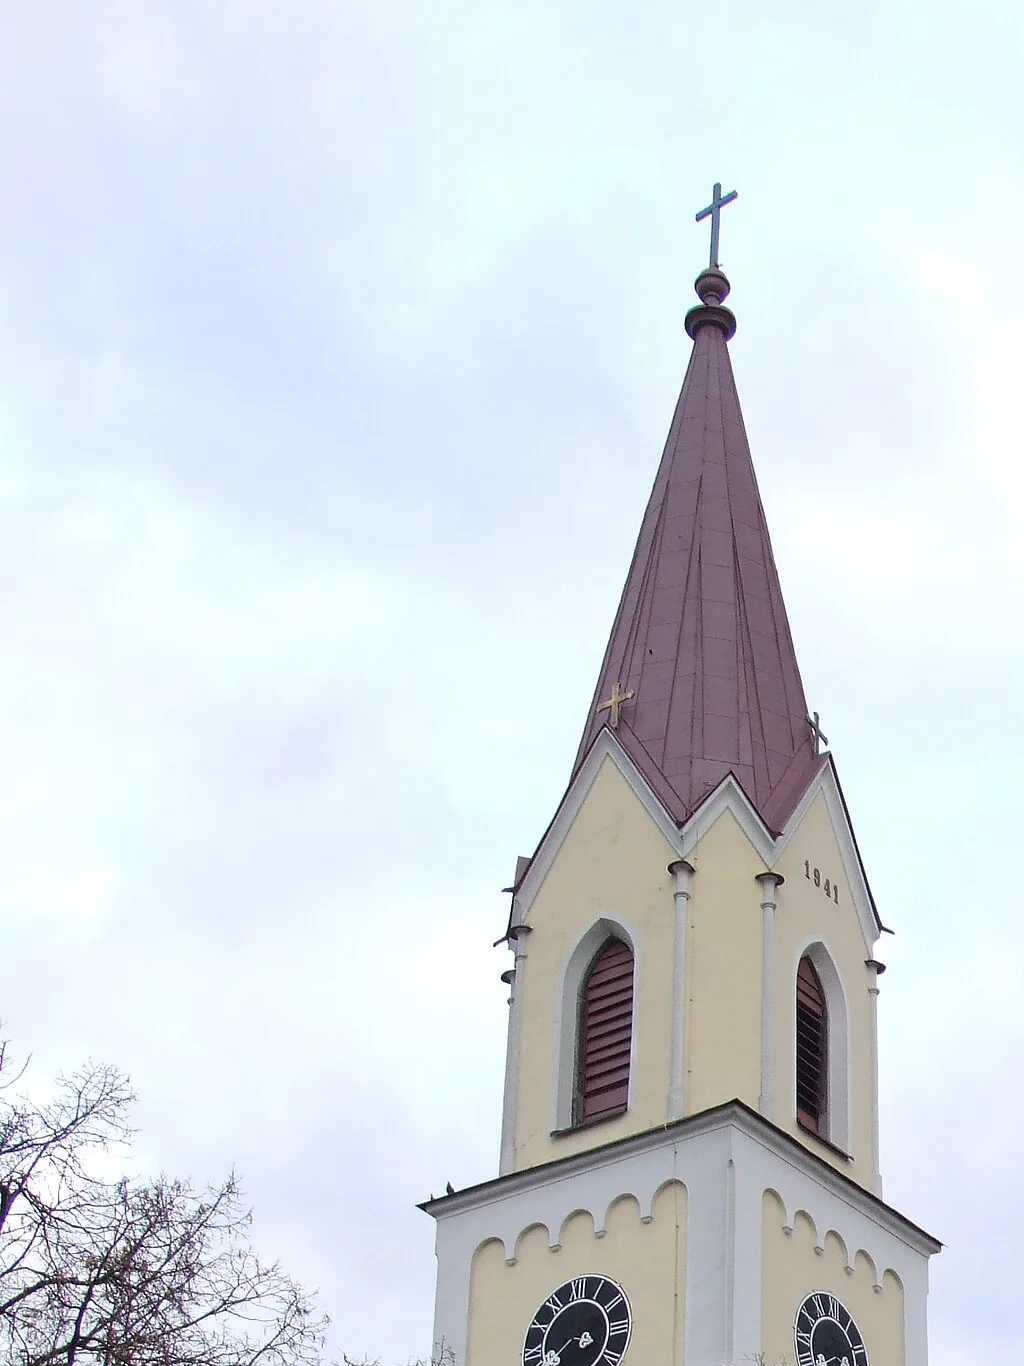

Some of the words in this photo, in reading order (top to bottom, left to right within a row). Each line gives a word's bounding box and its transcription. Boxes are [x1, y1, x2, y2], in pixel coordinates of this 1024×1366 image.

[804, 859, 839, 905] 1941
[569, 1278, 587, 1301] XII
[545, 1294, 564, 1315] XI
[603, 1293, 624, 1314] II
[811, 1294, 826, 1318] XI
[828, 1296, 840, 1321] XII
[531, 1319, 548, 1333] X
[801, 1305, 815, 1327] X
[609, 1319, 629, 1337] III
[797, 1327, 811, 1347] IX
[524, 1343, 542, 1361] IX
[852, 1344, 865, 1354] II
